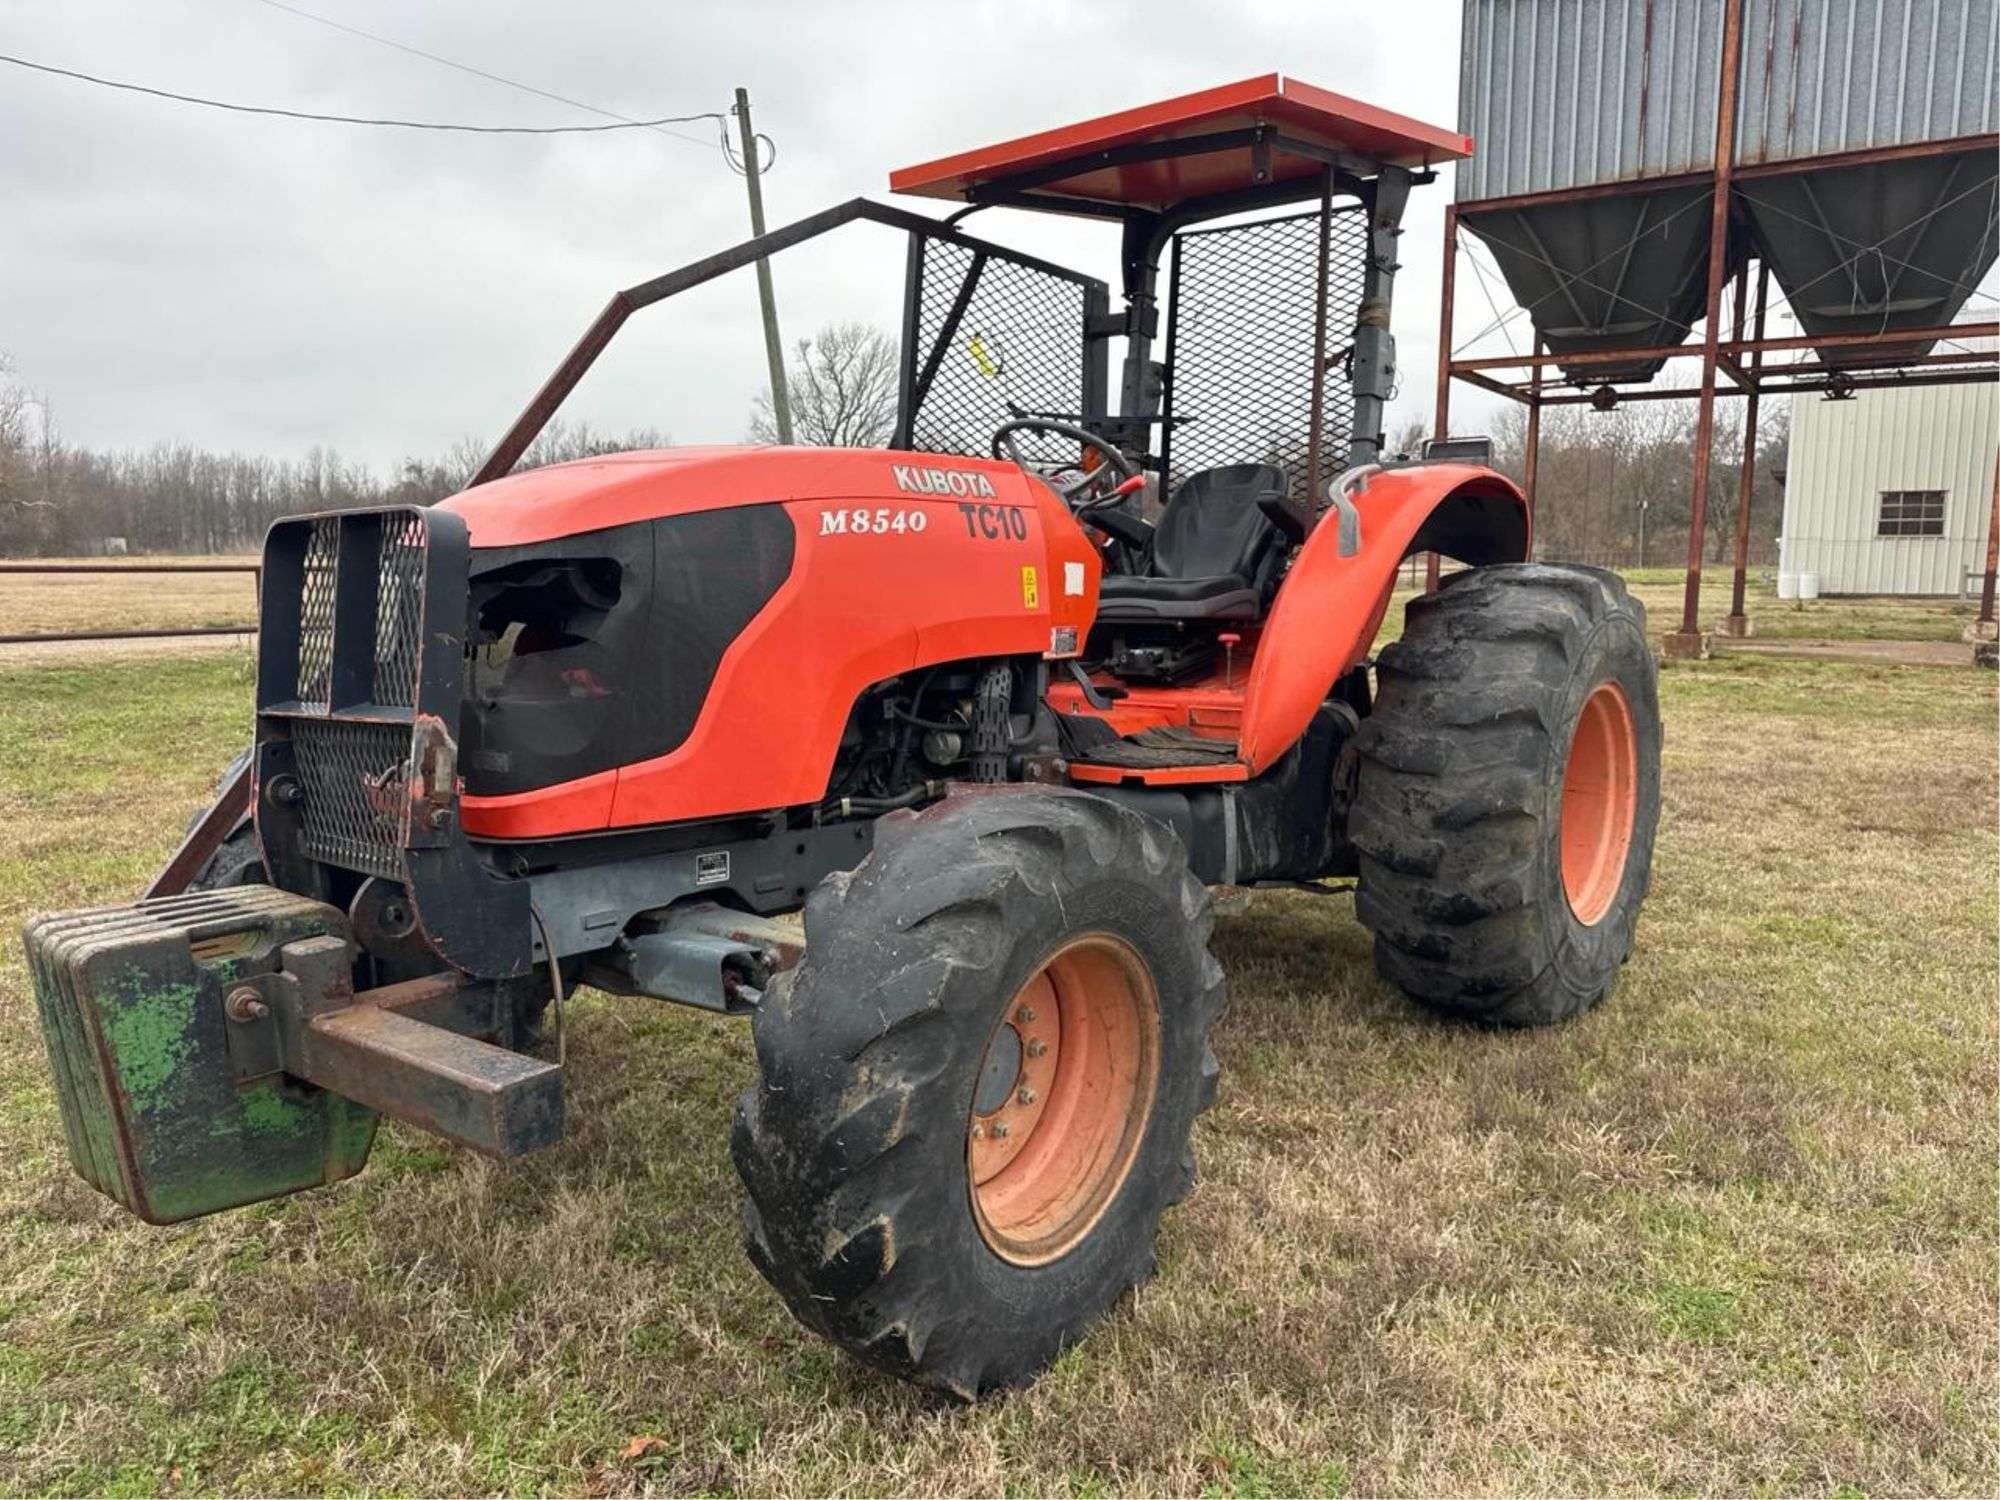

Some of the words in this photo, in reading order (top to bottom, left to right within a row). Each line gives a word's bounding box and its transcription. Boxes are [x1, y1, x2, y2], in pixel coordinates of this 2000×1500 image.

[893, 464, 996, 498] KUBOTA
[819, 508, 928, 536] M8540
[959, 502, 1028, 541] TC10
